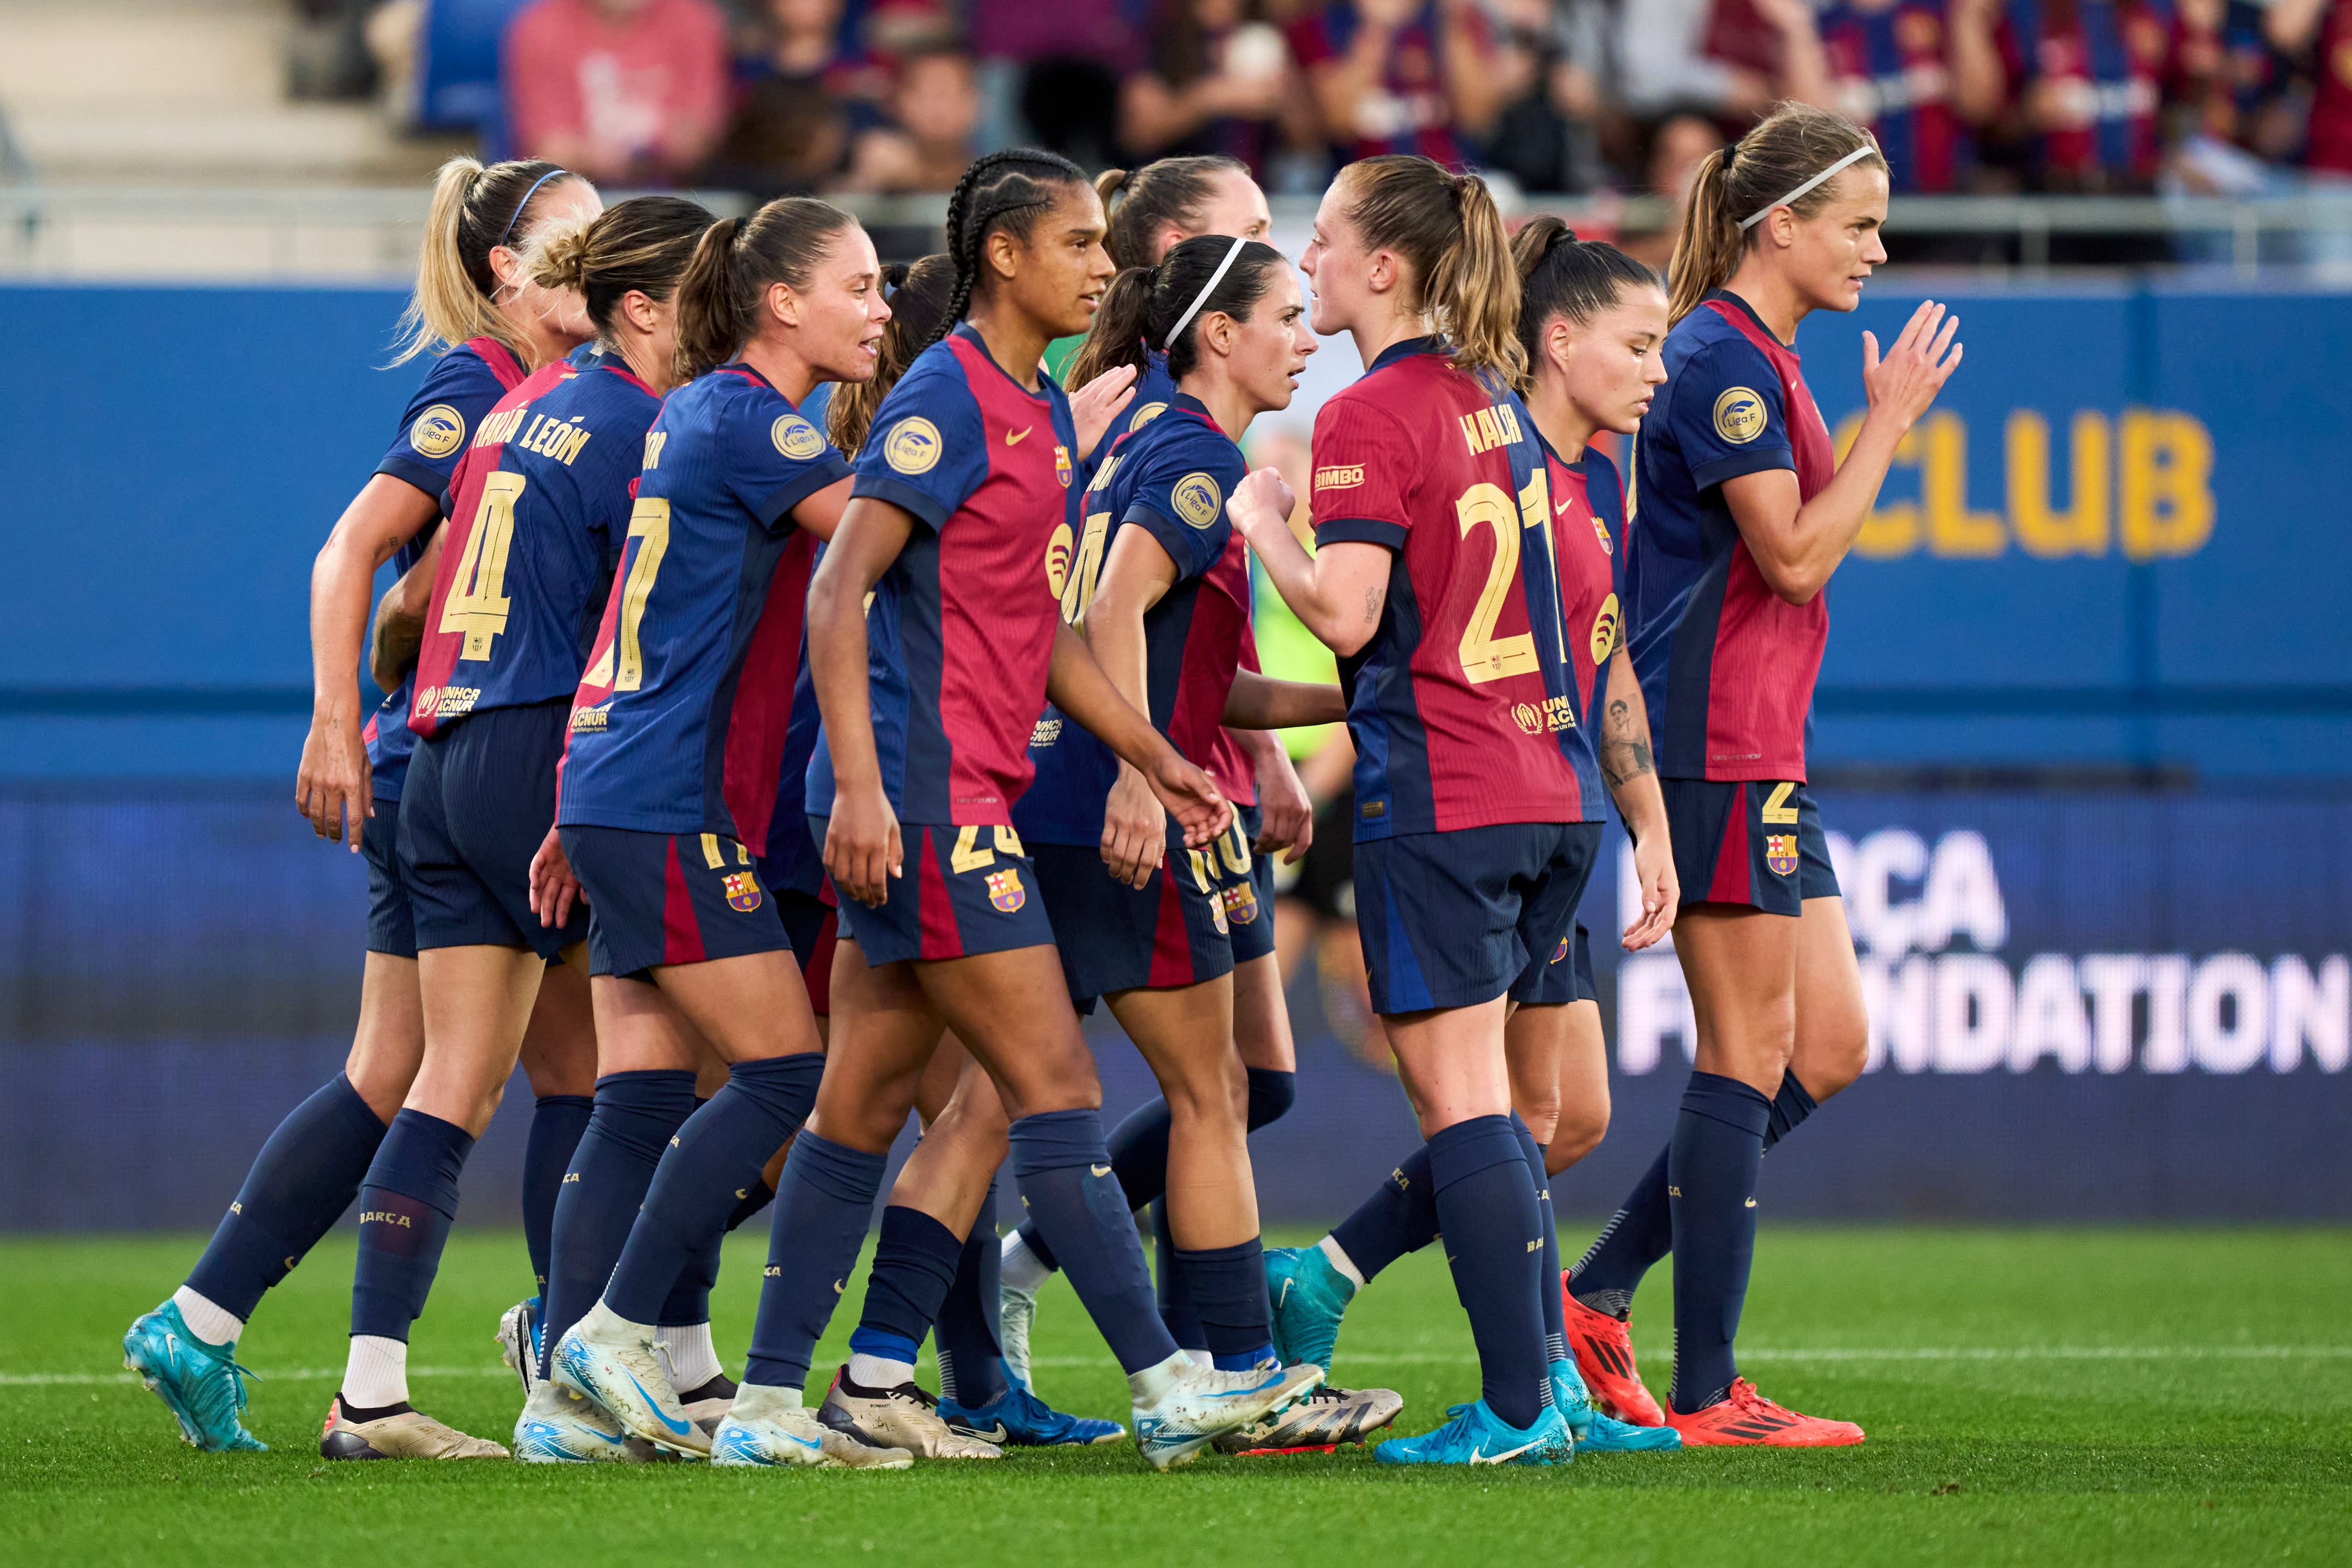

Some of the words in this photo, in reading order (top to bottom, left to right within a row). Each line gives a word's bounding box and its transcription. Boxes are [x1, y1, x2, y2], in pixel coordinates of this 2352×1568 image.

[1459, 403, 1523, 456] WALSH
[1727, 417, 1748, 426] Liga
[422, 428, 441, 441] Liga
[471, 400, 529, 449] MARÍA
[518, 414, 592, 466] LEÓN
[790, 436, 810, 445] Liga
[1315, 468, 1364, 488] BIMBO
[1832, 408, 2215, 559] CLUB
[1185, 493, 1201, 511] Liga
[439, 471, 526, 661] 4
[1455, 468, 1567, 684] 21
[581, 498, 670, 691] 7
[441, 686, 481, 700] UNHCR
[435, 699, 475, 711] ACNUR
[1541, 695, 1570, 713] UN
[571, 712, 607, 728] ACNUR
[1035, 719, 1063, 731] NHCR
[1617, 953, 2350, 1074] FNDATION
[360, 1211, 410, 1229] BARÇA
